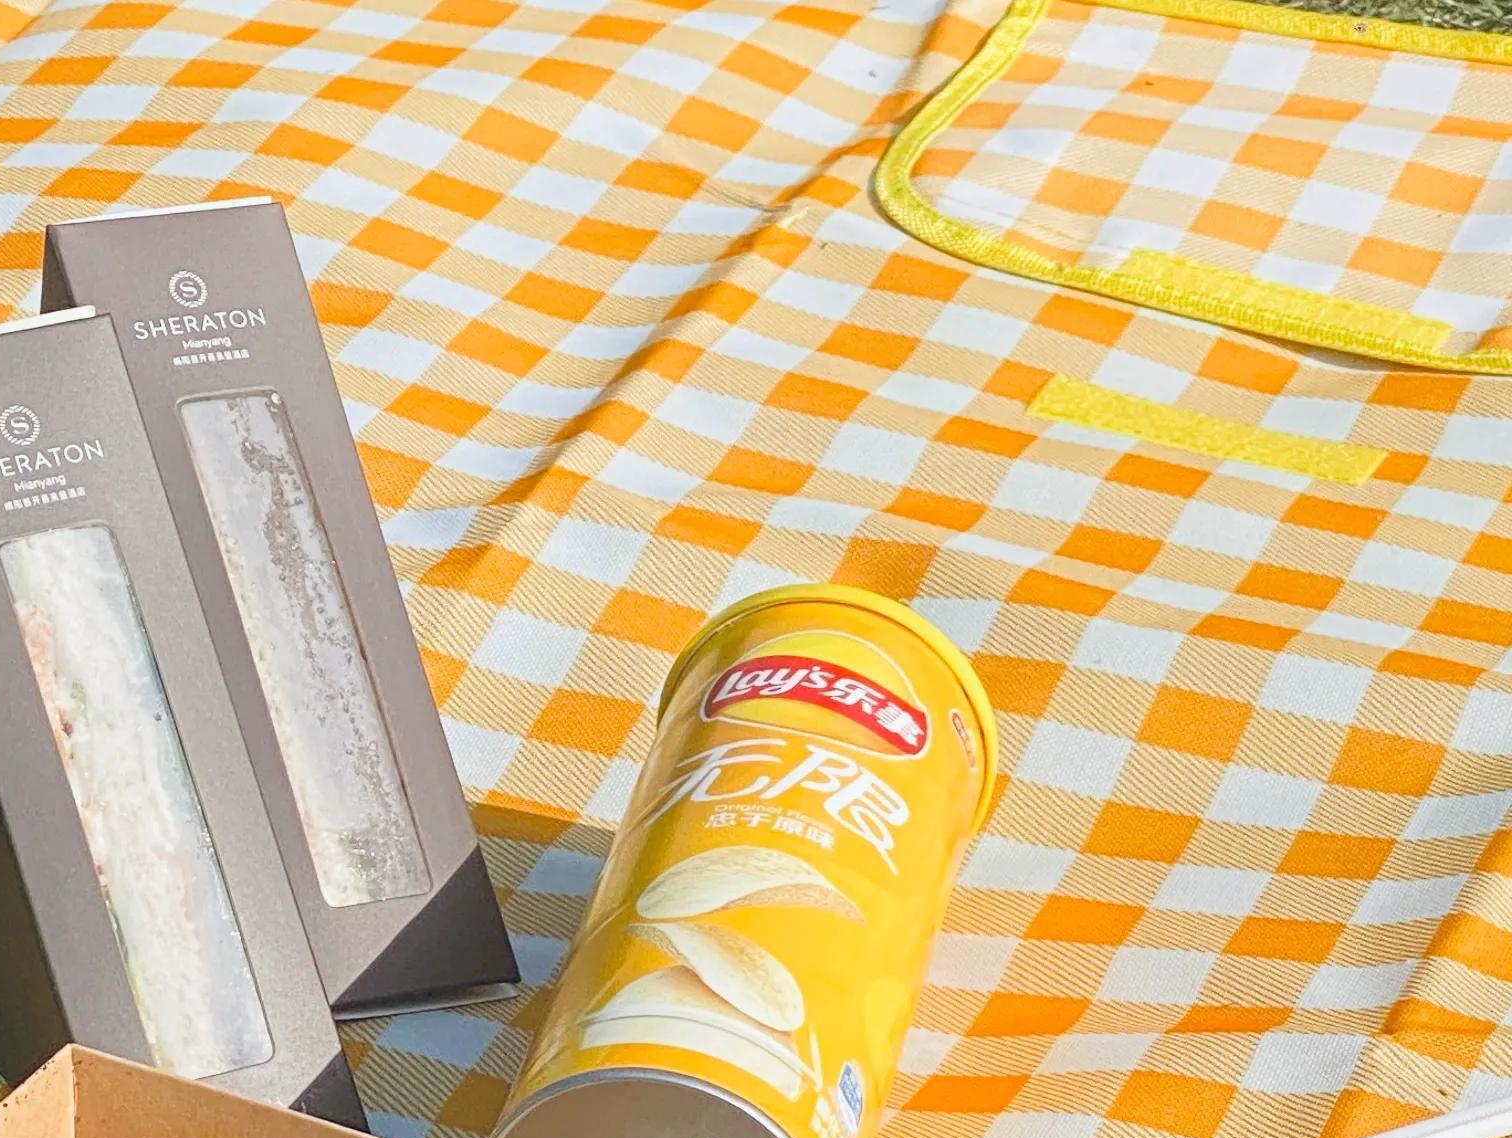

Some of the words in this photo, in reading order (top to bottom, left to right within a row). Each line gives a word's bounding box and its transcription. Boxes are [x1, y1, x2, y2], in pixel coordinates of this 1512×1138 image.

[133, 308, 266, 340] SHERATON
[182, 336, 232, 350] Mianyang
[14, 474, 67, 493] Mianyang
